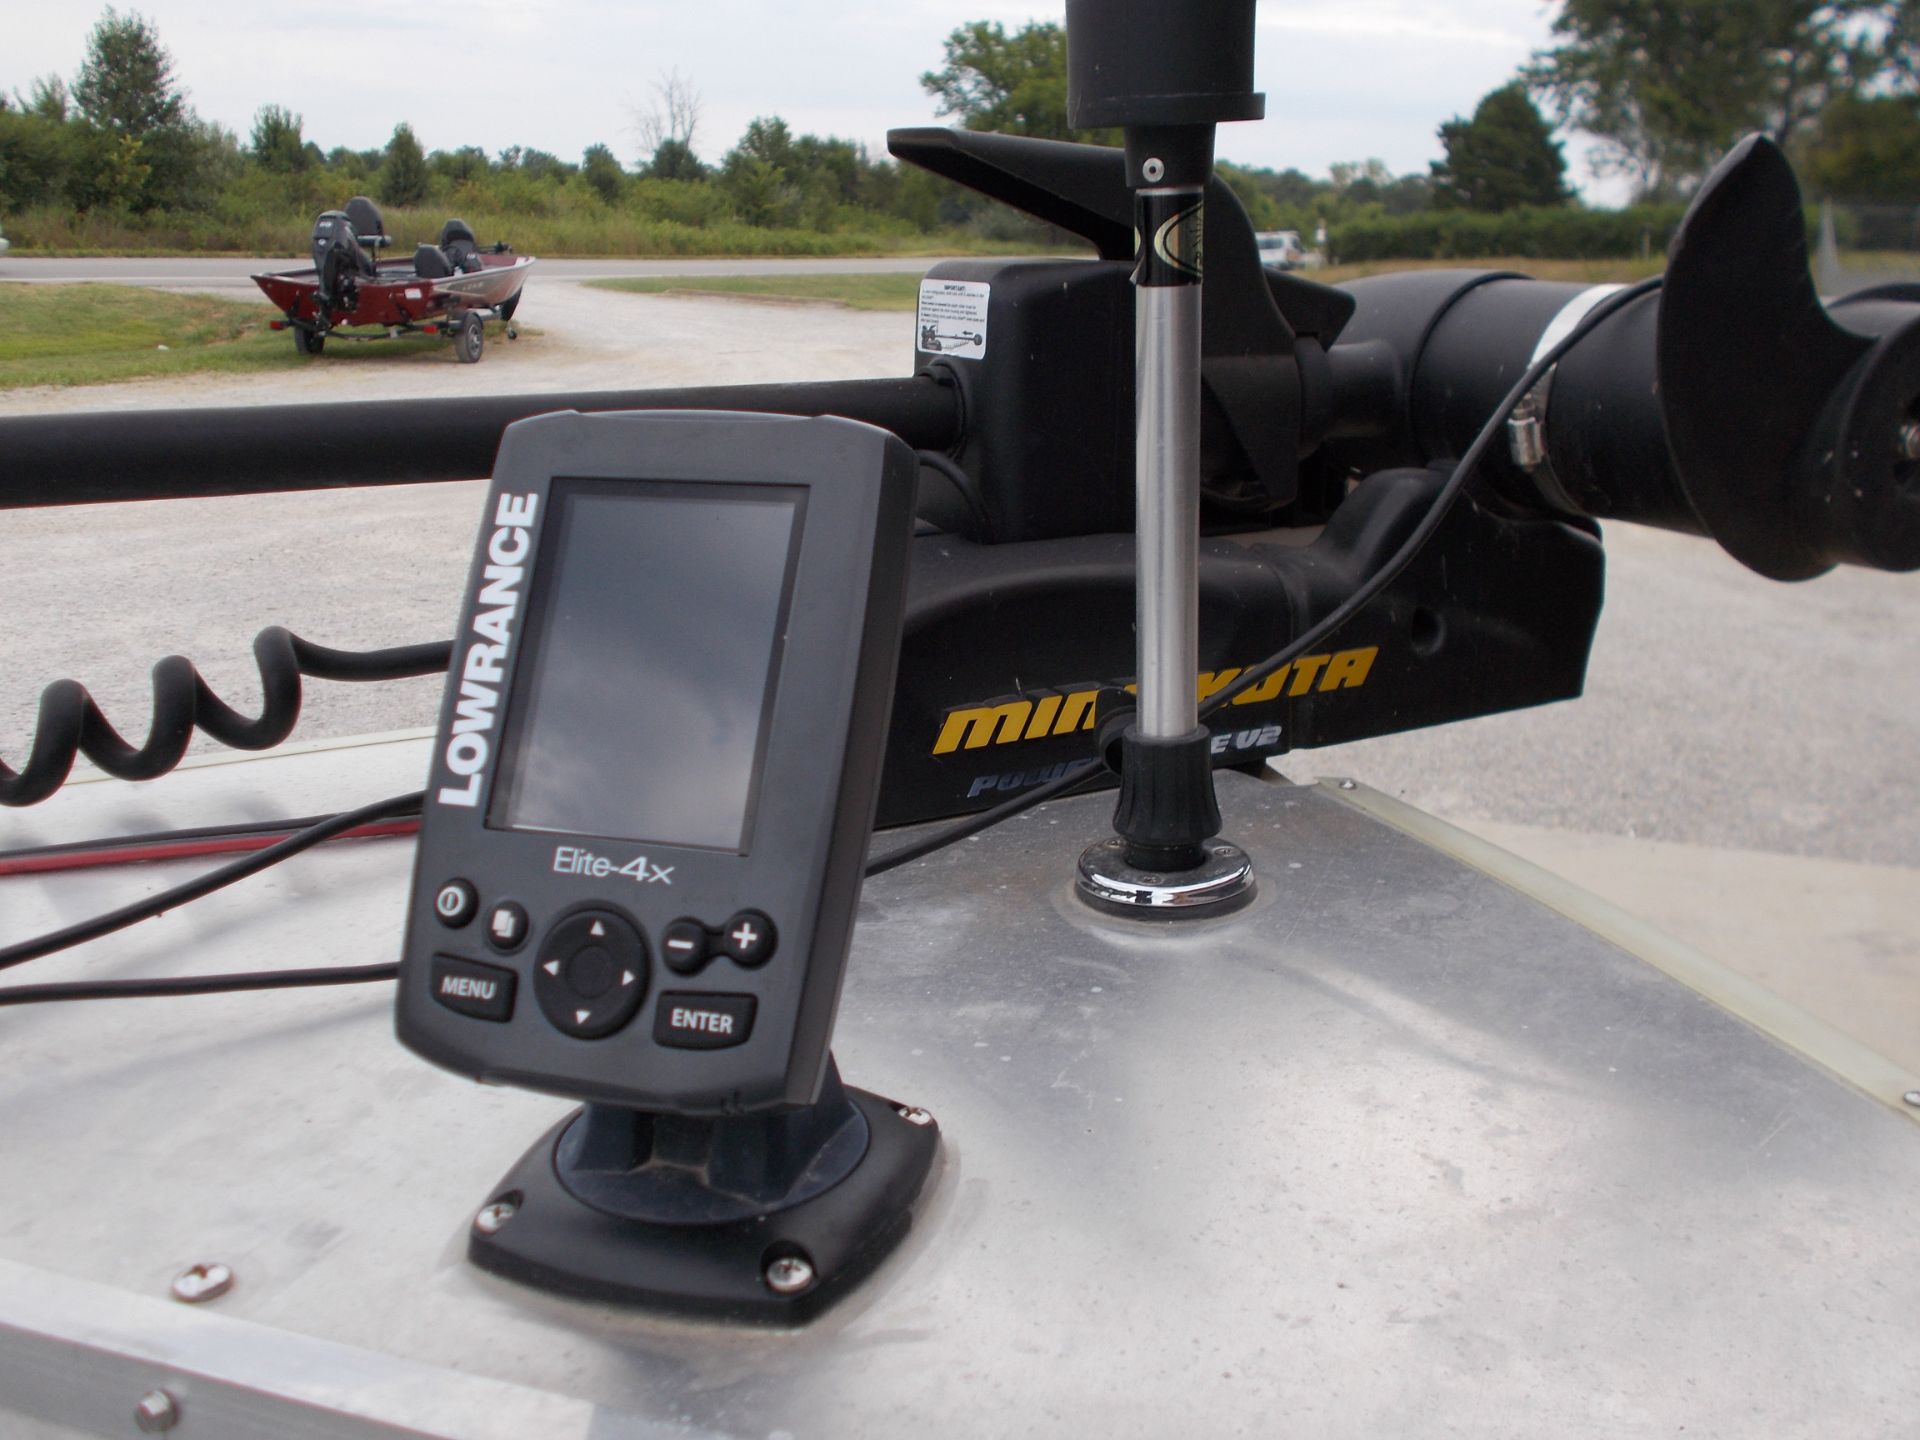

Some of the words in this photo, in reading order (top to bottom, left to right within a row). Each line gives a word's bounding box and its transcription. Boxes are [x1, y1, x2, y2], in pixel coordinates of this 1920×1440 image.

[438, 492, 538, 807] LOWRANCE
[932, 683, 1136, 755] MIN
[553, 845, 676, 885] Elite-4x
[441, 975, 496, 1001] MENU
[671, 1007, 734, 1035] ENTER
